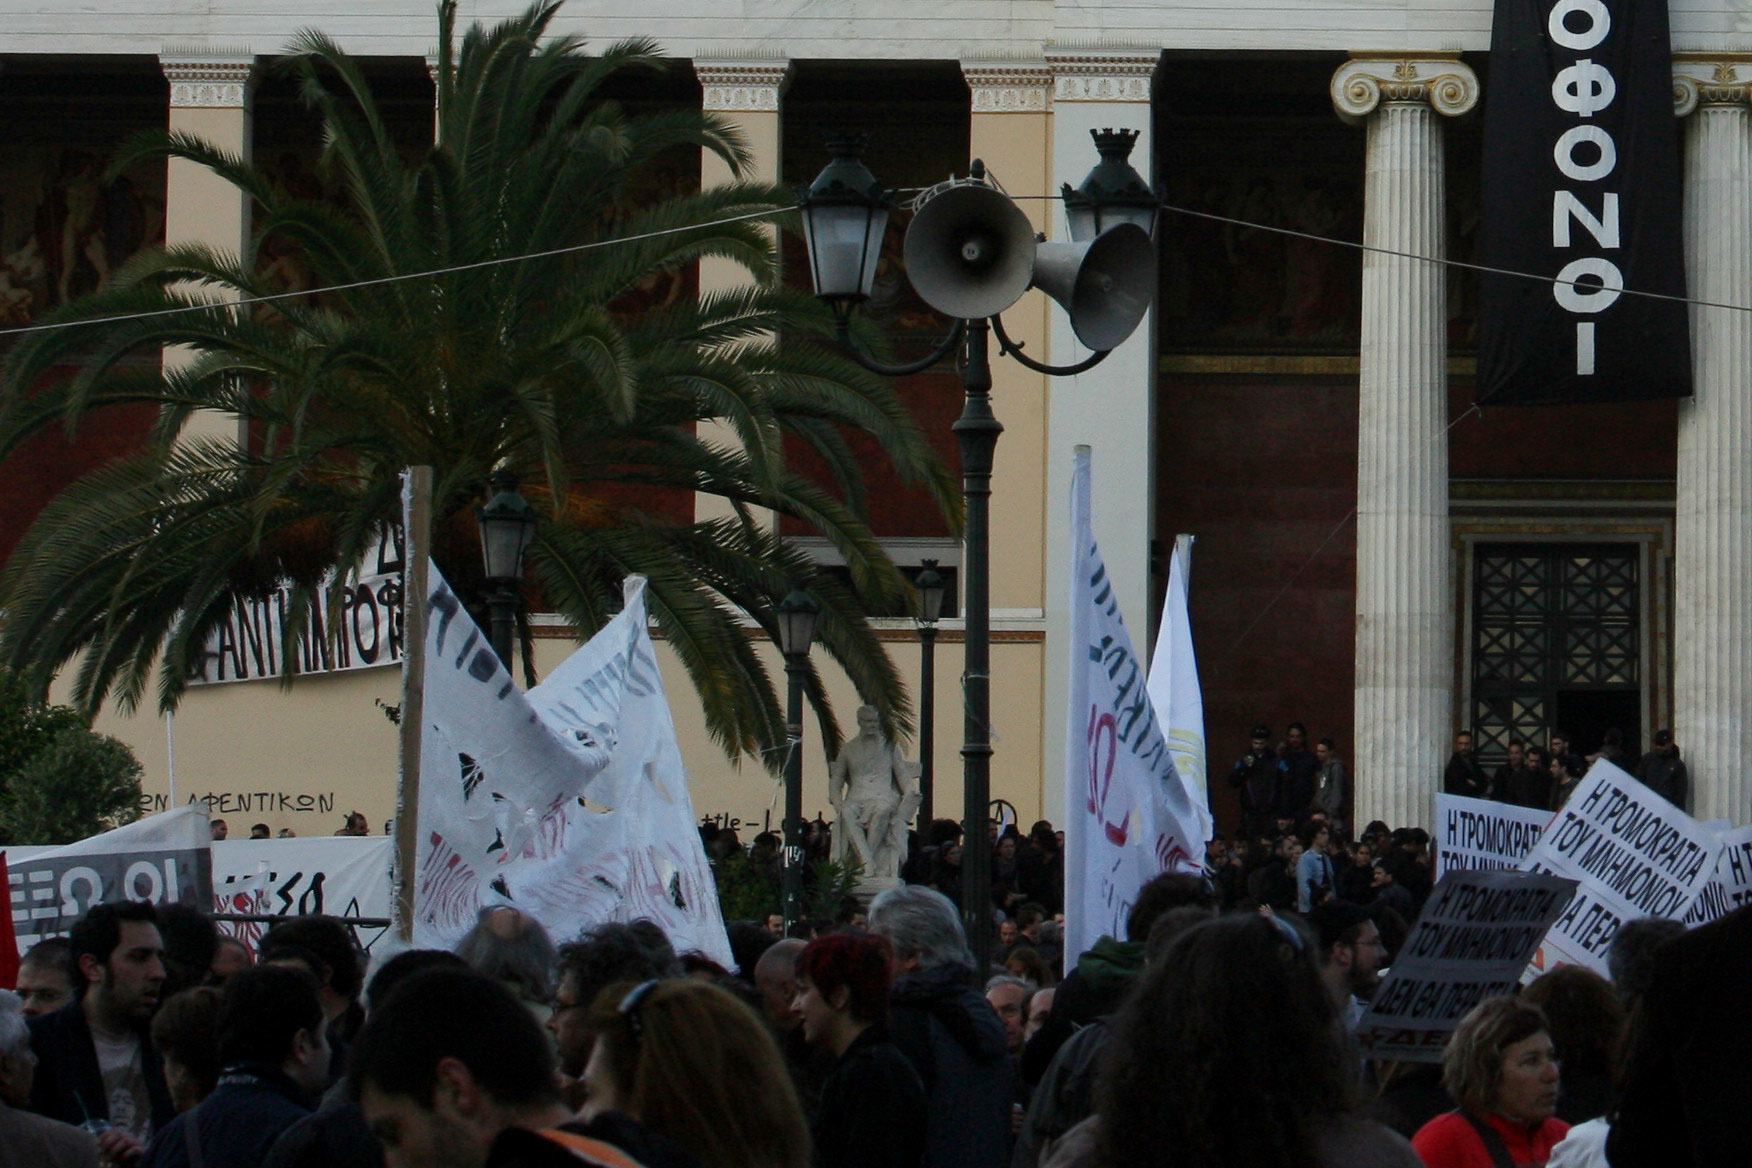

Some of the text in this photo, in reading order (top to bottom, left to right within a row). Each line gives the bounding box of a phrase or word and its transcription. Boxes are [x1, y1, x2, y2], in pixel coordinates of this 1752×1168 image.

[1447, 809, 1457, 846] Η
[1580, 779, 1708, 887] Η ΤΡΟΜΟΚΡΑΤΙΑ
[1550, 811, 1689, 918] ΤΟΥ ΜΝΗΜΟΝΙΟΥ
[1453, 884, 1558, 922] ΤΡΟΜΟΚΡΑΤΙΑ
[1409, 921, 1448, 958] ΤΟΥ
[1439, 925, 1542, 961] ΜΝΗΜΟΝΙΟΥ
[1372, 978, 1418, 1016] ΔΕΝ
[1412, 980, 1446, 1019] ΘΑ
